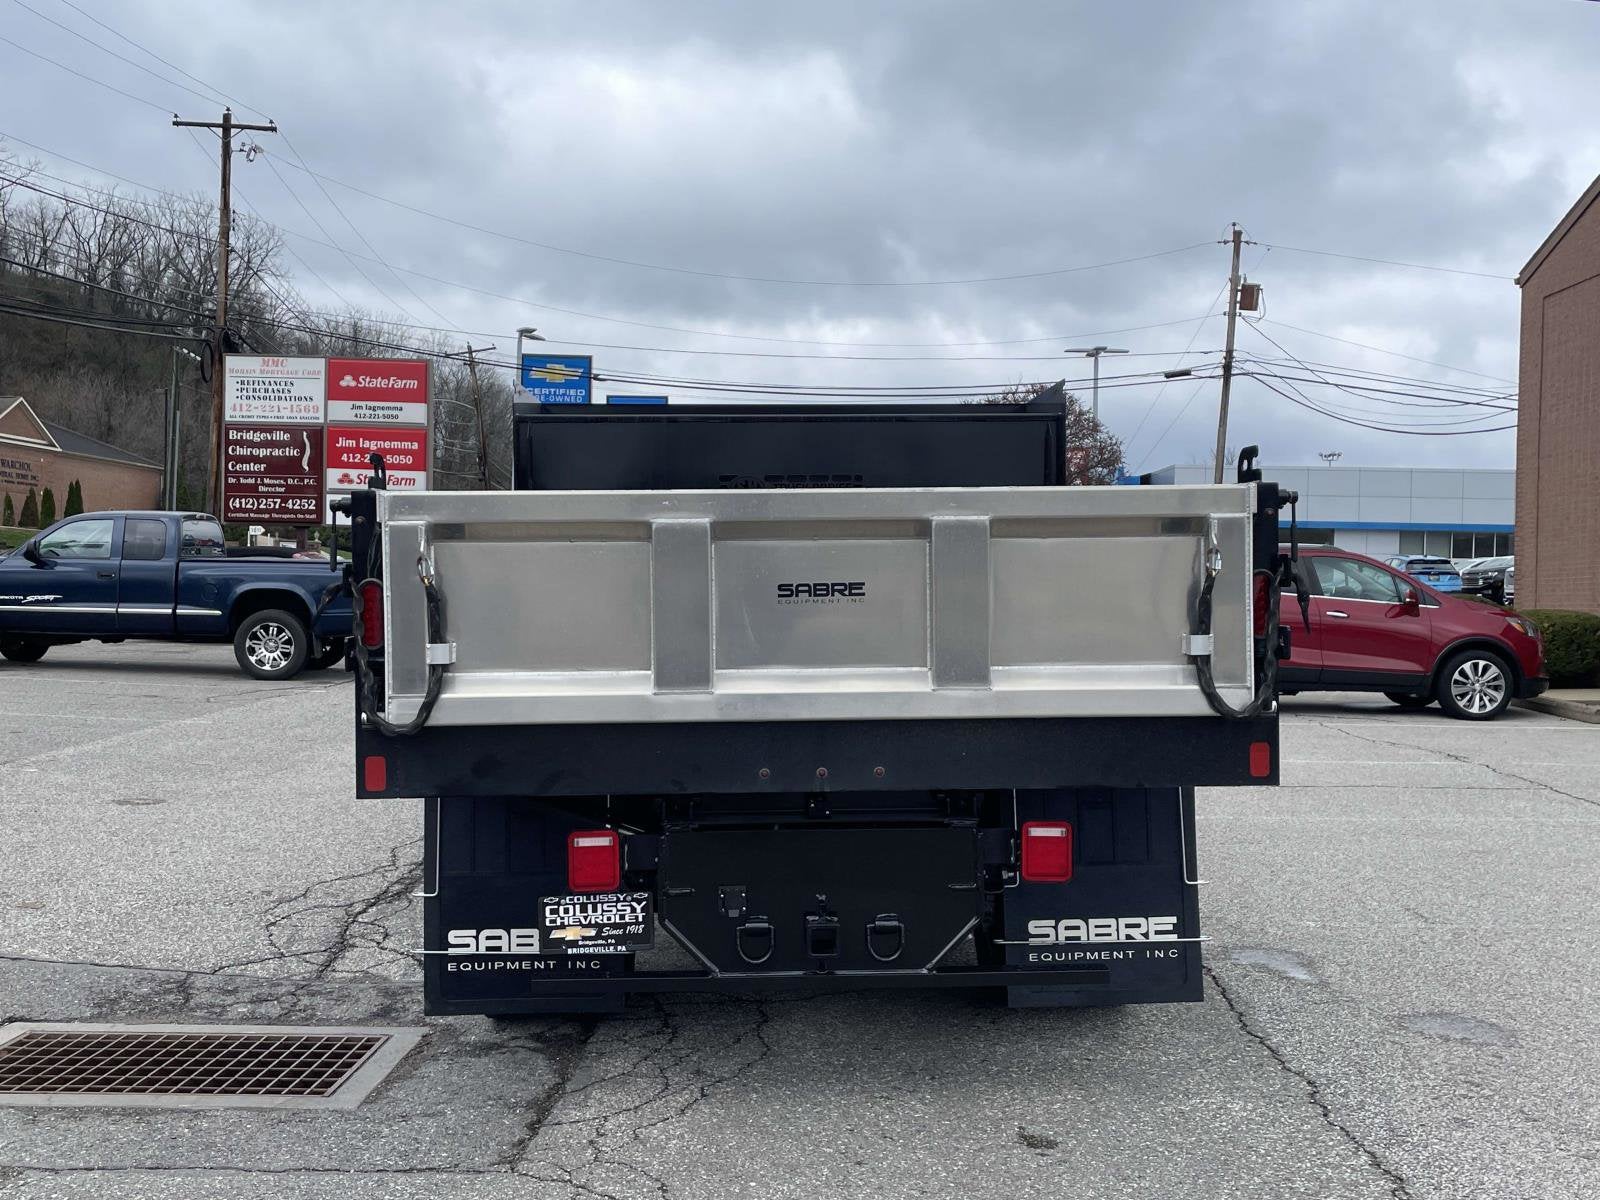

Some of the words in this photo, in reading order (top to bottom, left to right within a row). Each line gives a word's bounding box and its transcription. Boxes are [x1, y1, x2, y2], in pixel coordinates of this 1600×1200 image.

[261, 358, 288, 367] MMC
[358, 376, 418, 388] StateFarm
[527, 388, 586, 396] CERTIFIED
[366, 404, 403, 412] Iagnemma
[228, 430, 290, 442] Bridgeville
[336, 437, 356, 447] Jim
[360, 438, 418, 450] Iagnemma
[228, 446, 300, 458] Chiropractic
[342, 454, 412, 464] 412-2-5050
[228, 461, 266, 472] Center
[356, 474, 416, 486] StFarm
[229, 498, 258, 510] (412)
[259, 499, 316, 510] 257-4252
[777, 582, 866, 598] SABRE
[565, 894, 626, 904] COLUSSY
[545, 902, 646, 918] COLUSSY
[546, 913, 646, 926] CHEVROLET
[602, 927, 624, 936] Since
[626, 925, 644, 934] 1918
[1028, 916, 1178, 946] SABRE
[448, 928, 540, 954] SAB
[1029, 951, 1134, 961] EQUIPMENT
[1146, 950, 1178, 958] INC
[448, 961, 556, 972] EQUIPMENT
[568, 960, 600, 969] INC
